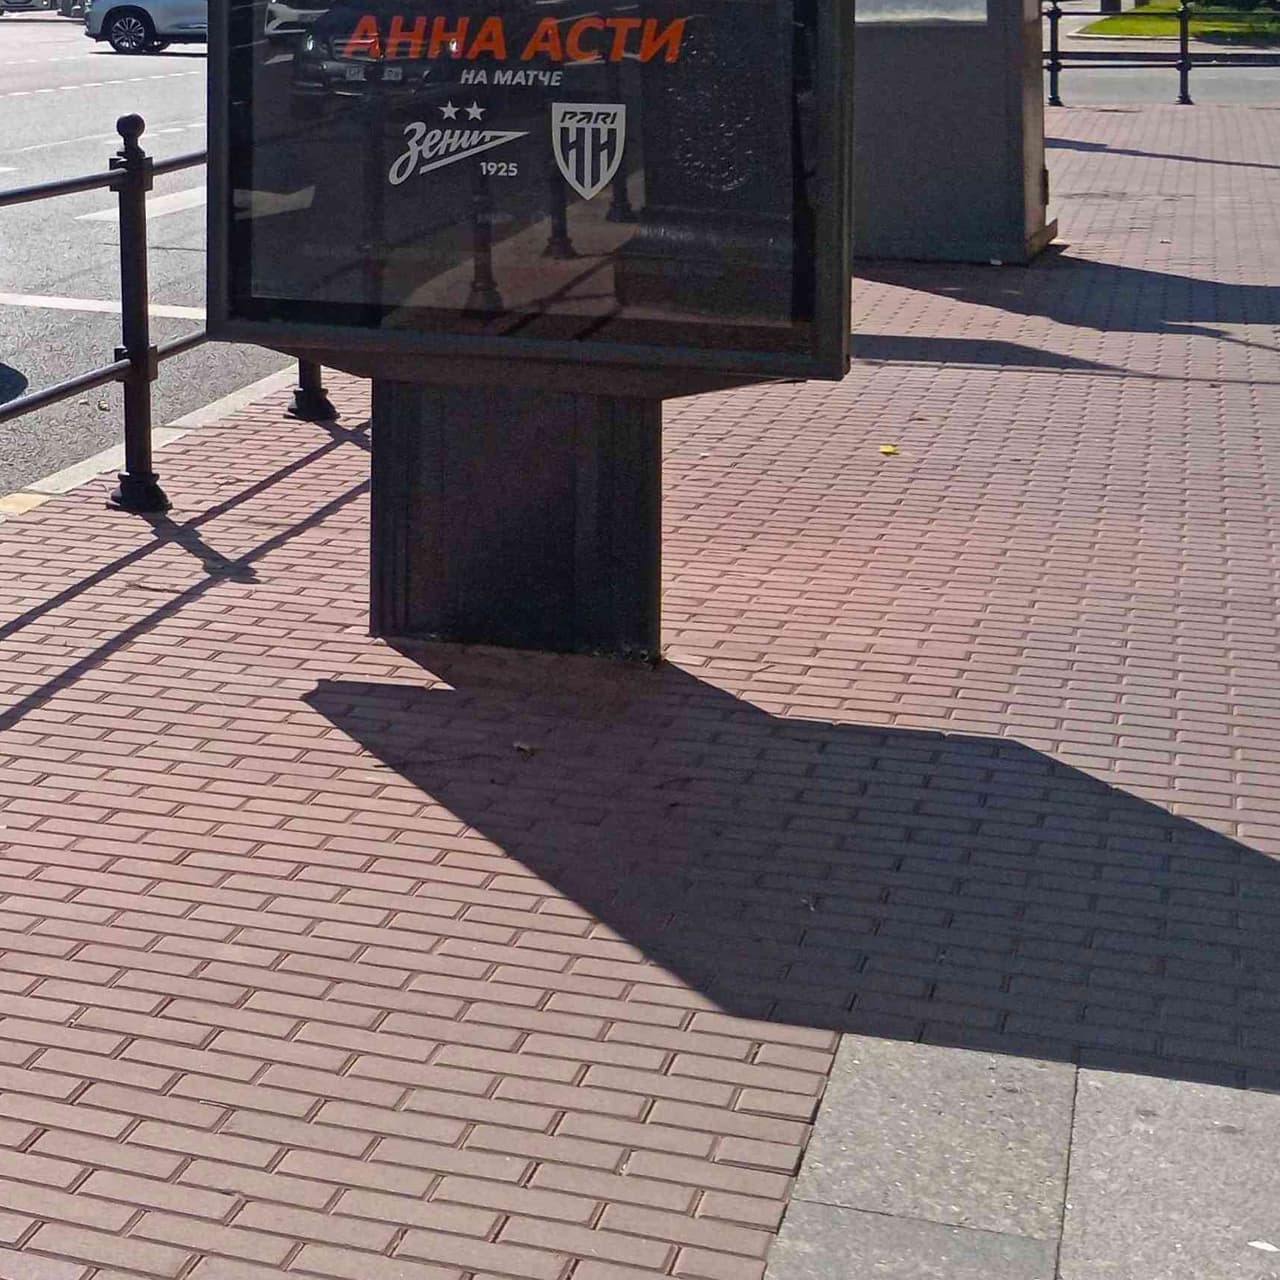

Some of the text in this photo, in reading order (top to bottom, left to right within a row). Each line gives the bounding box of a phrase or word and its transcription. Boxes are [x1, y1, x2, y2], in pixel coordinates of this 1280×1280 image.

[343, 15, 686, 63] АННА АСТИ
[460, 68, 564, 87] НА МАТЧЕ
[480, 161, 519, 177] 1925
